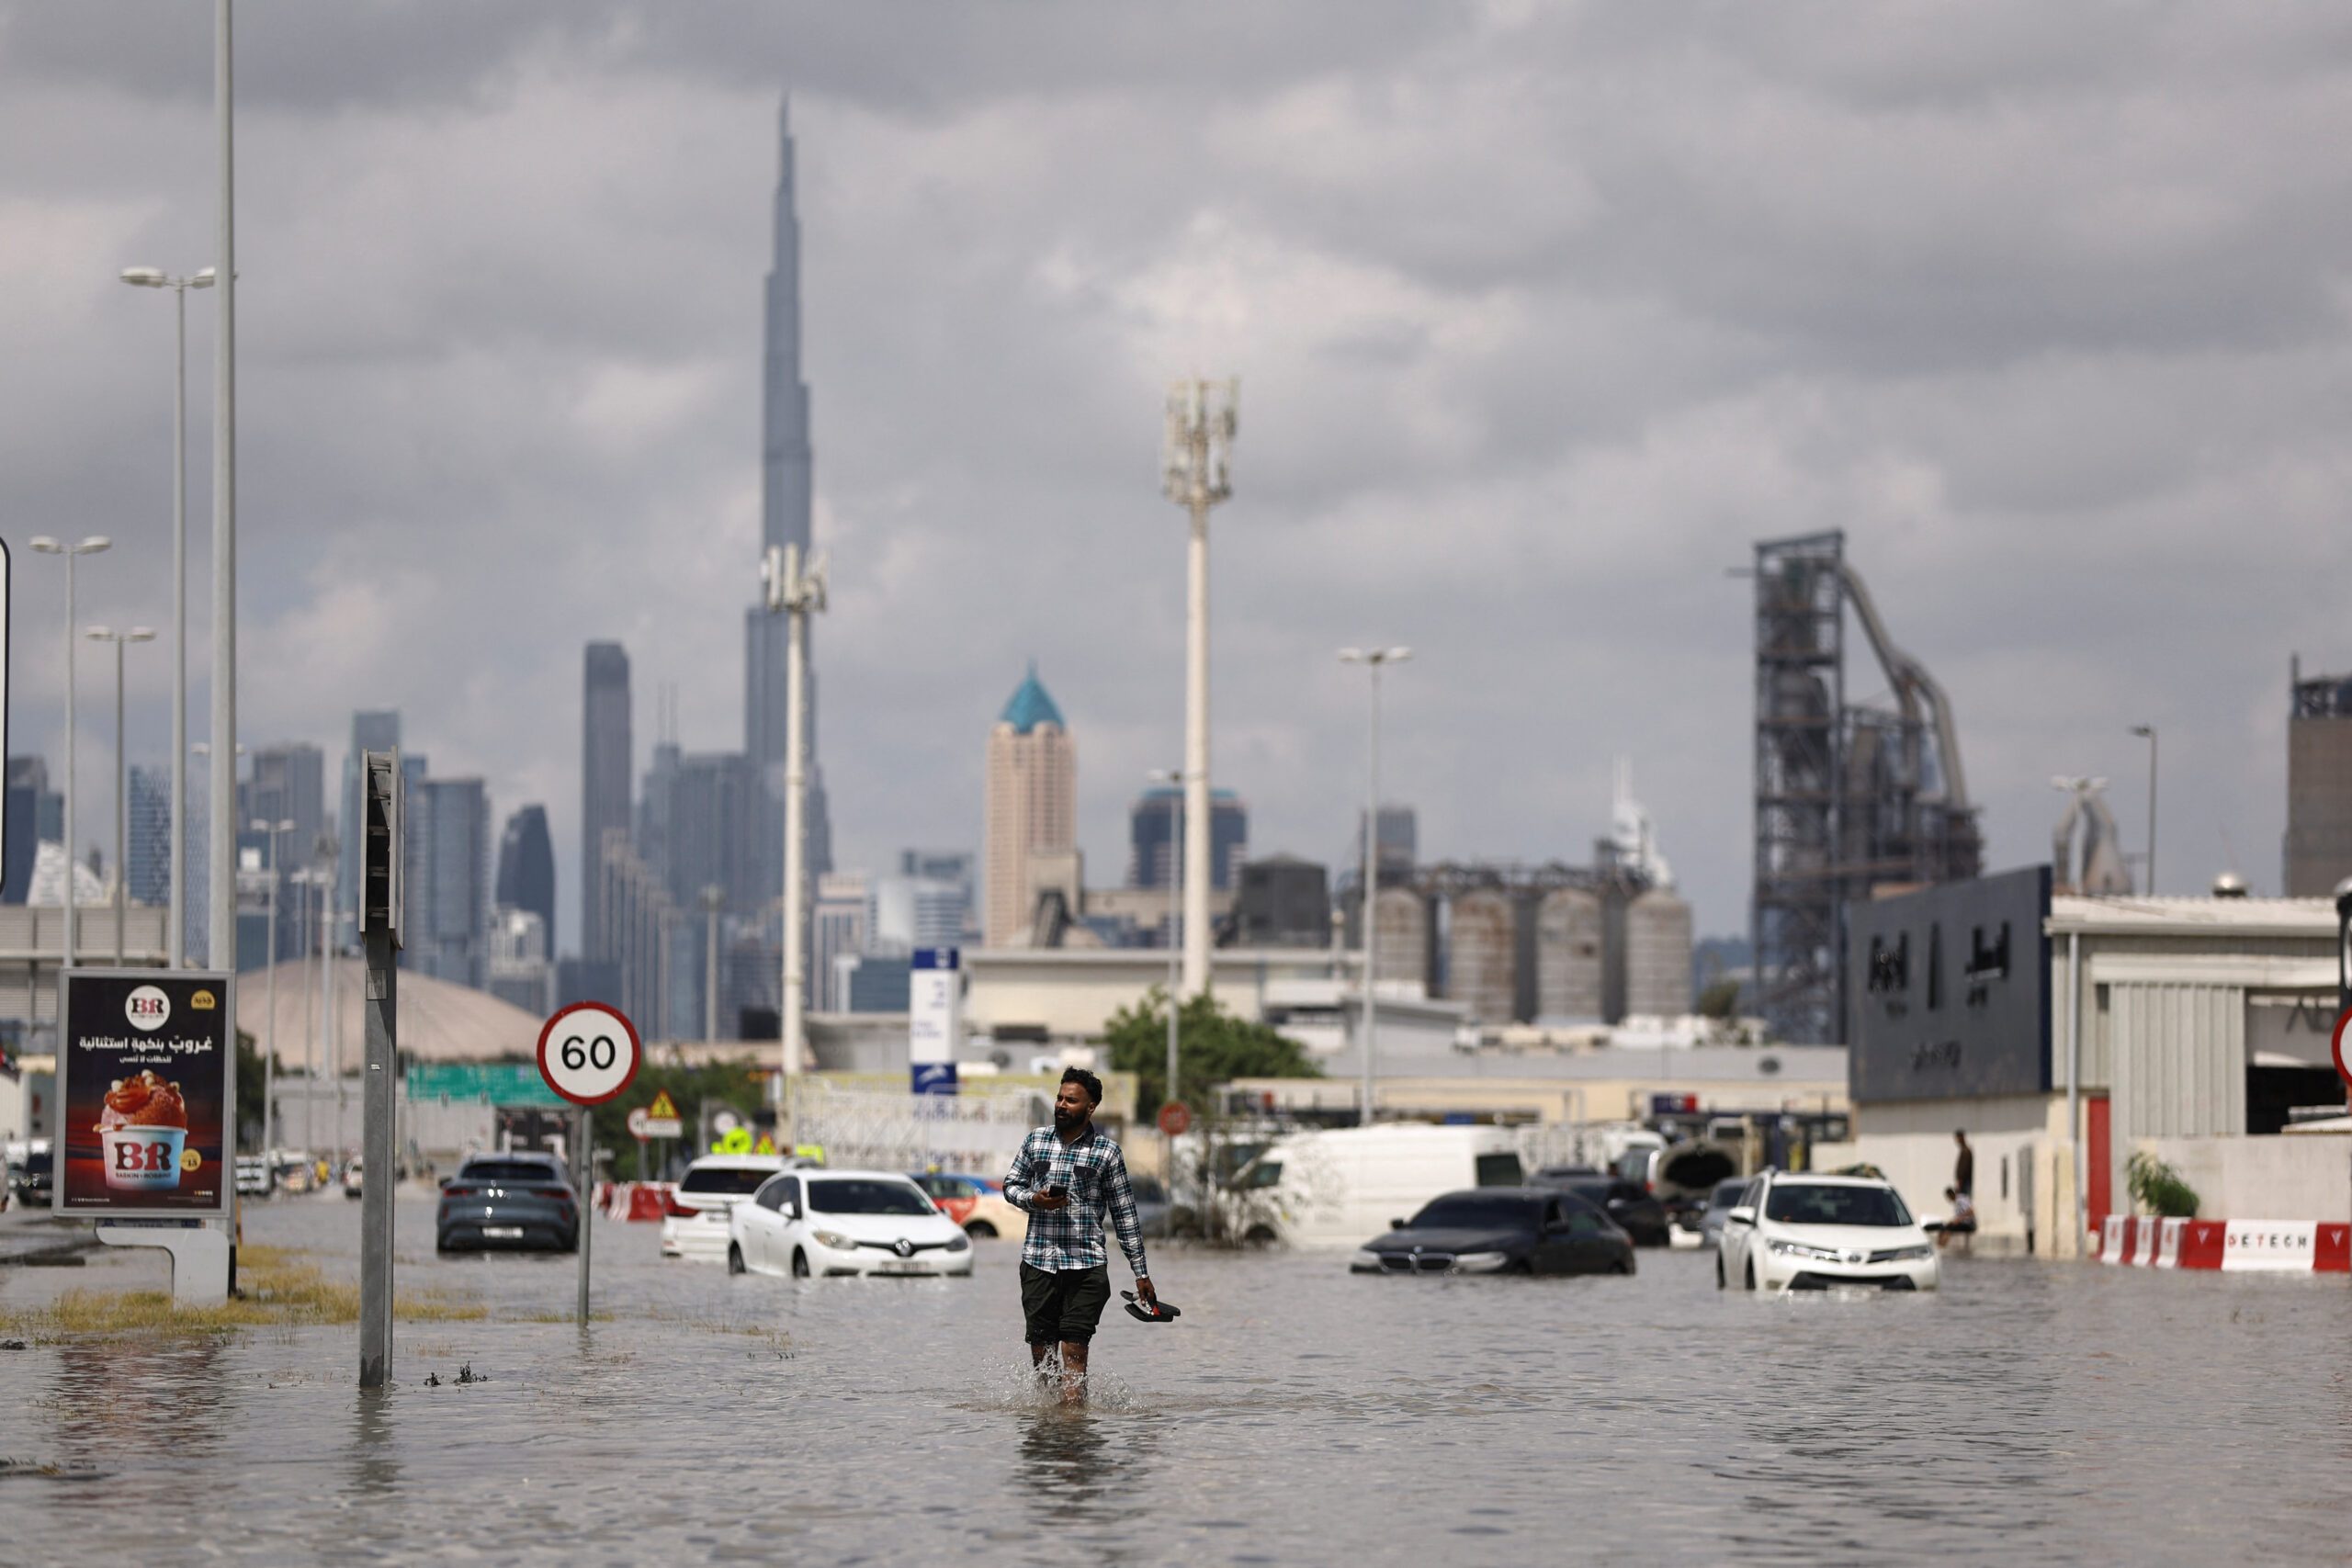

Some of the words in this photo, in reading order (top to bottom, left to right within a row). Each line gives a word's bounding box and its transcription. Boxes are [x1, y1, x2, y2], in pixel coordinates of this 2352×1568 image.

[131, 998, 164, 1014] BR
[561, 1035, 616, 1070] 60
[114, 1142, 172, 1170] BR
